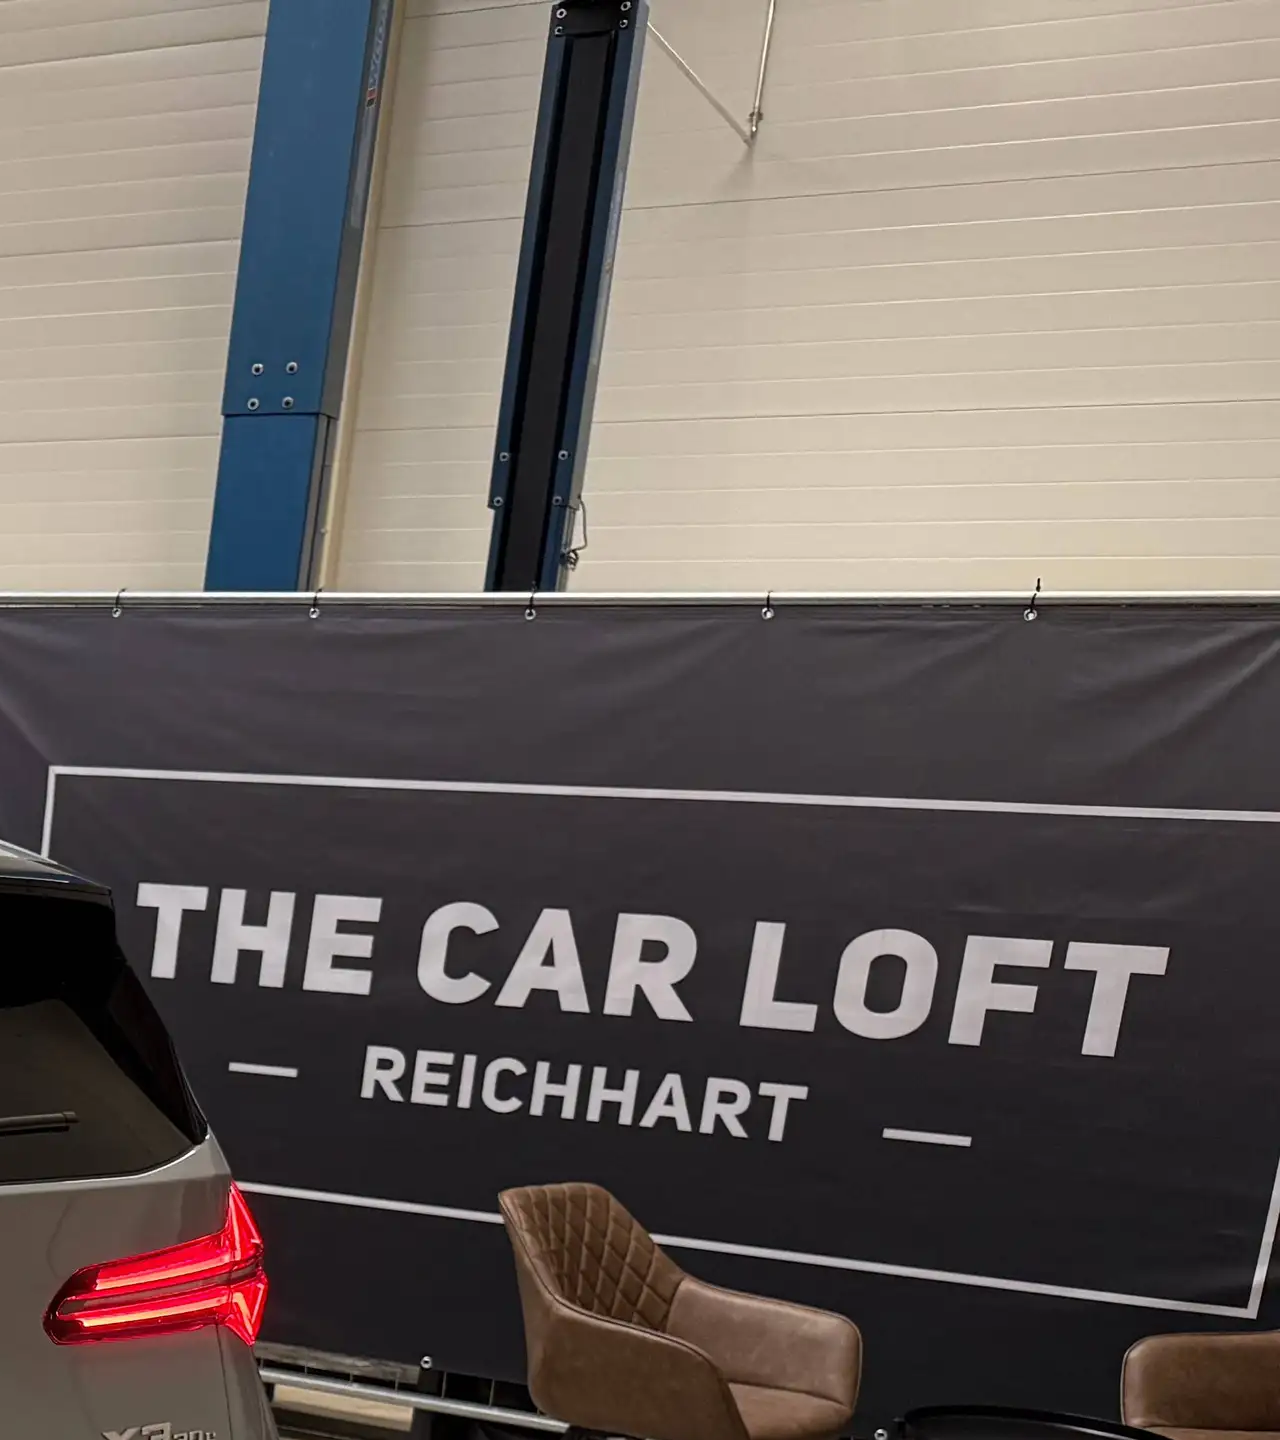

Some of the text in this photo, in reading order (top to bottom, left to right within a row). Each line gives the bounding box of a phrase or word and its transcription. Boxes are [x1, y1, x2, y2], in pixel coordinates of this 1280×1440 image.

[136, 882, 1171, 1057] THE CAR LOFT
[360, 1045, 809, 1142] REICHHART
